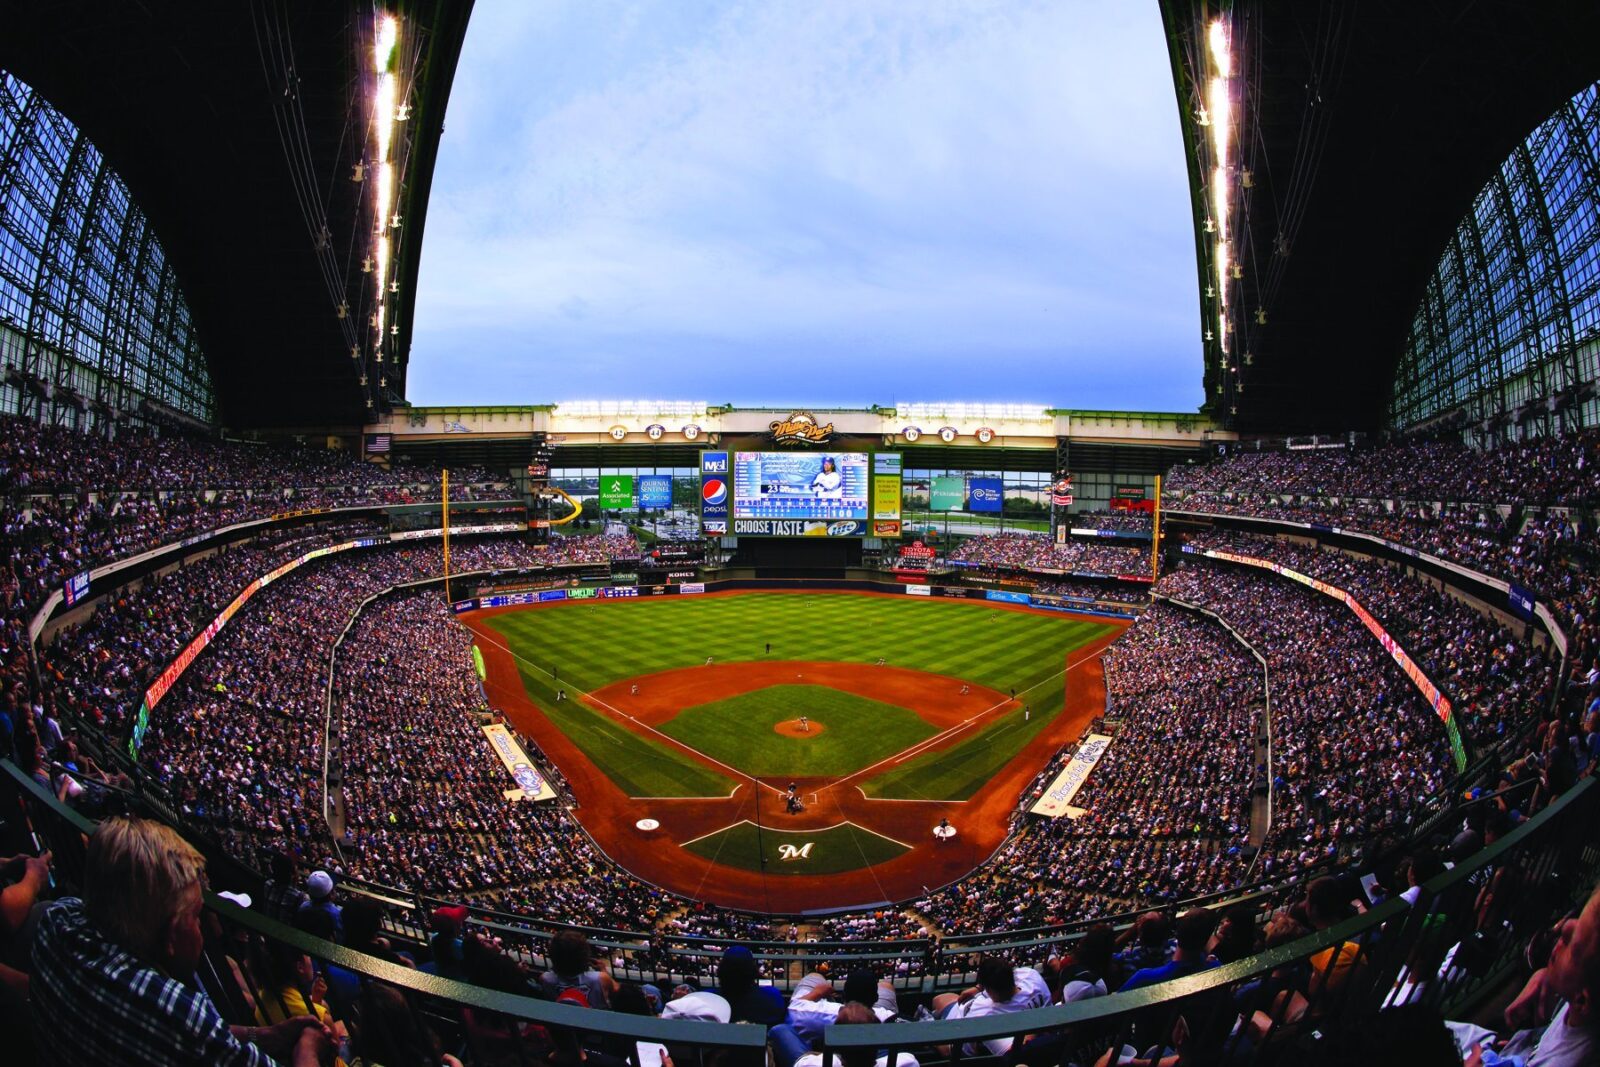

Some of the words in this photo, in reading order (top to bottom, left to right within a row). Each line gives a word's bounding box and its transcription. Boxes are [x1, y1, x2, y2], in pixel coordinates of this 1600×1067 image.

[769, 421, 808, 438] Miller
[802, 422, 833, 440] Park
[767, 485, 778, 493] 23
[703, 505, 727, 513] pepsi
[734, 520, 770, 533] CHOOSE
[778, 842, 816, 860] M
